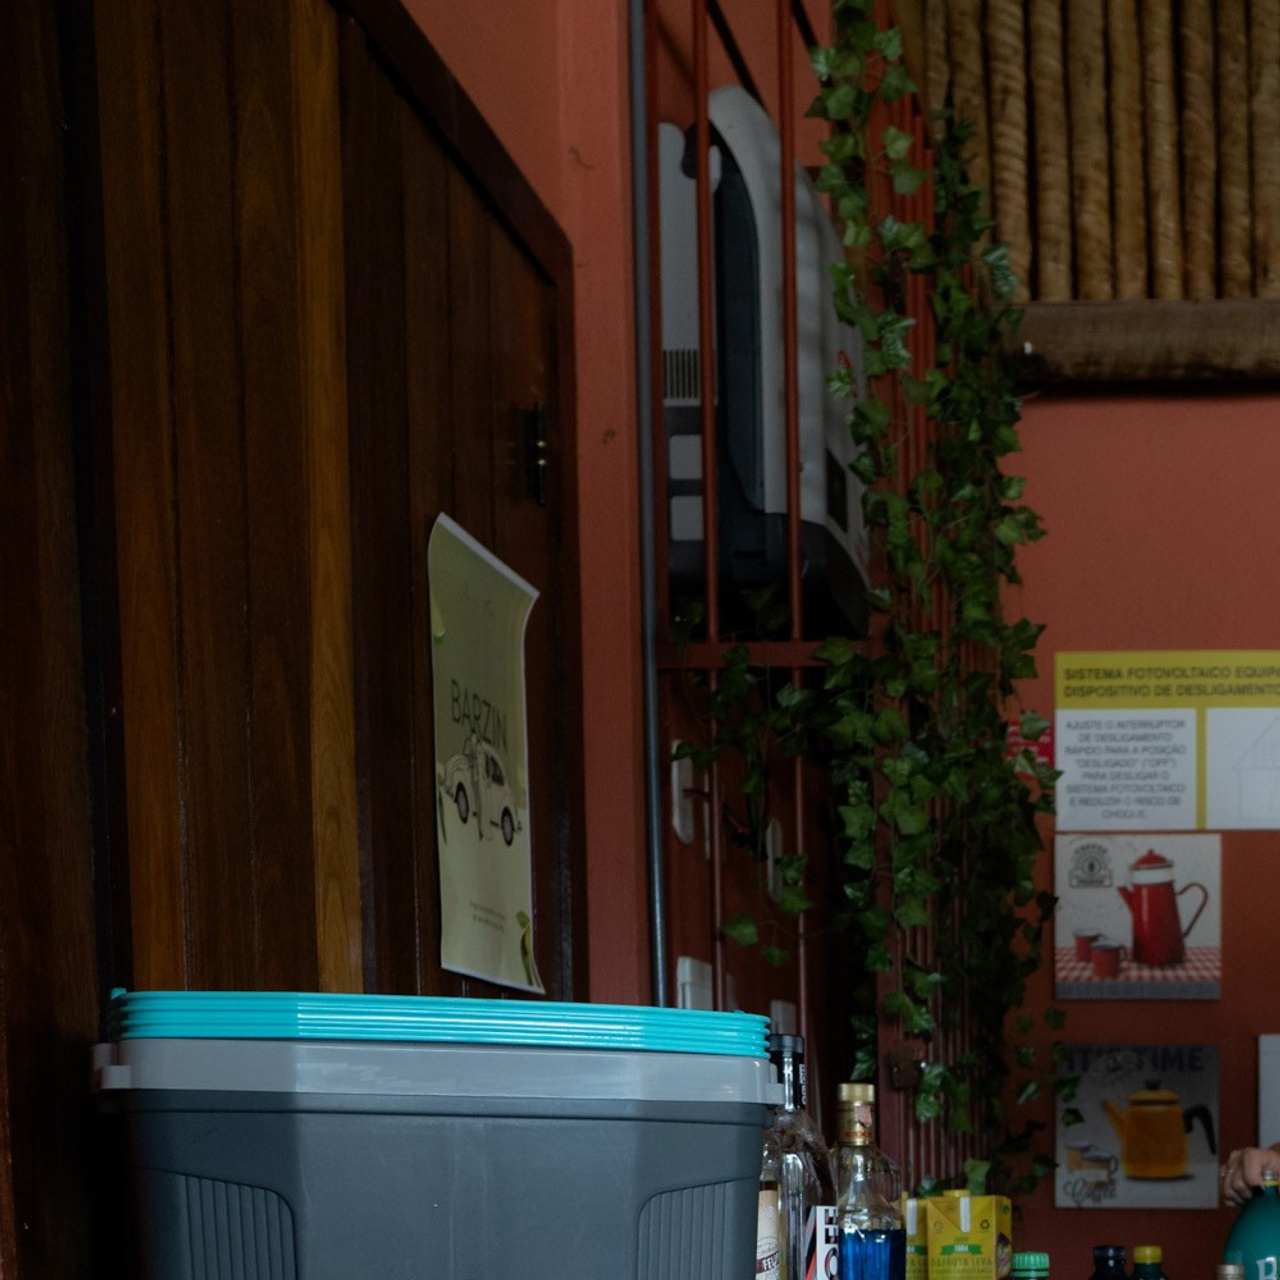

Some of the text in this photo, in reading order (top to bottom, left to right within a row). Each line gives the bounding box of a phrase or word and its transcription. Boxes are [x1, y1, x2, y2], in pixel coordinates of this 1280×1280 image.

[1064, 667, 1121, 680] SISTEMA
[1127, 667, 1230, 679] FOTOVOLTAICO
[1063, 685, 1150, 698] DISPOSITIVO
[1154, 684, 1171, 697] DE
[451, 679, 508, 753] BARZIN
[1065, 720, 1185, 730] AJUSTE O INTERRUPTOR
[1078, 732, 1173, 743] DE DESLIGAMENTO
[1104, 745, 1130, 755] PARA
[1133, 1046, 1205, 1072] TIME
